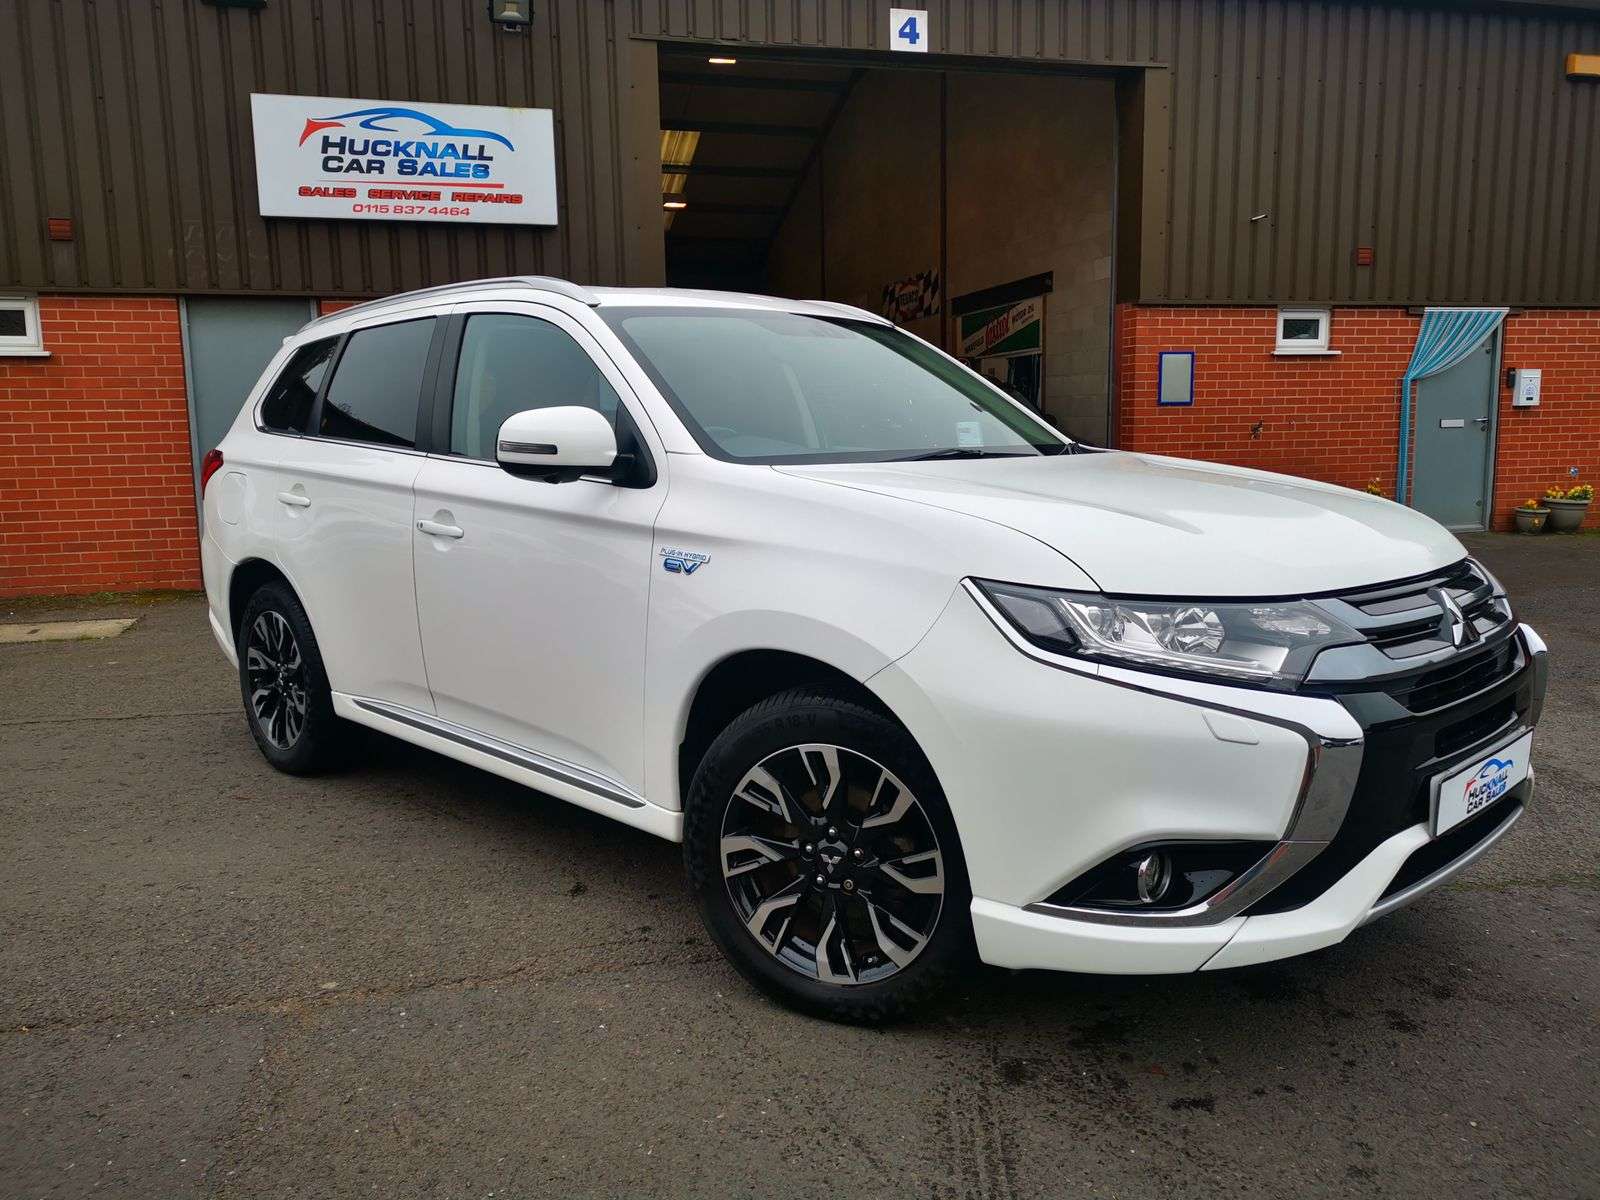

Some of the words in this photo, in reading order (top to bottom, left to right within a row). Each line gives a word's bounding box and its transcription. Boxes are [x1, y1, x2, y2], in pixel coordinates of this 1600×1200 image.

[898, 16, 920, 45] 4
[321, 136, 493, 161] HUCKNALL
[321, 156, 385, 175] CAR
[397, 159, 490, 179] SALES
[298, 186, 357, 200] SALES
[368, 188, 441, 202] SERVICE
[451, 191, 524, 205] REPAIRS
[352, 203, 390, 215] 0115
[393, 204, 426, 216] 837
[428, 205, 470, 217] 4464
[683, 552, 707, 561] HYBRID
[1466, 798, 1484, 815] CAR
[1485, 781, 1508, 803] SALES
[1467, 769, 1509, 803] HUCKNALL
